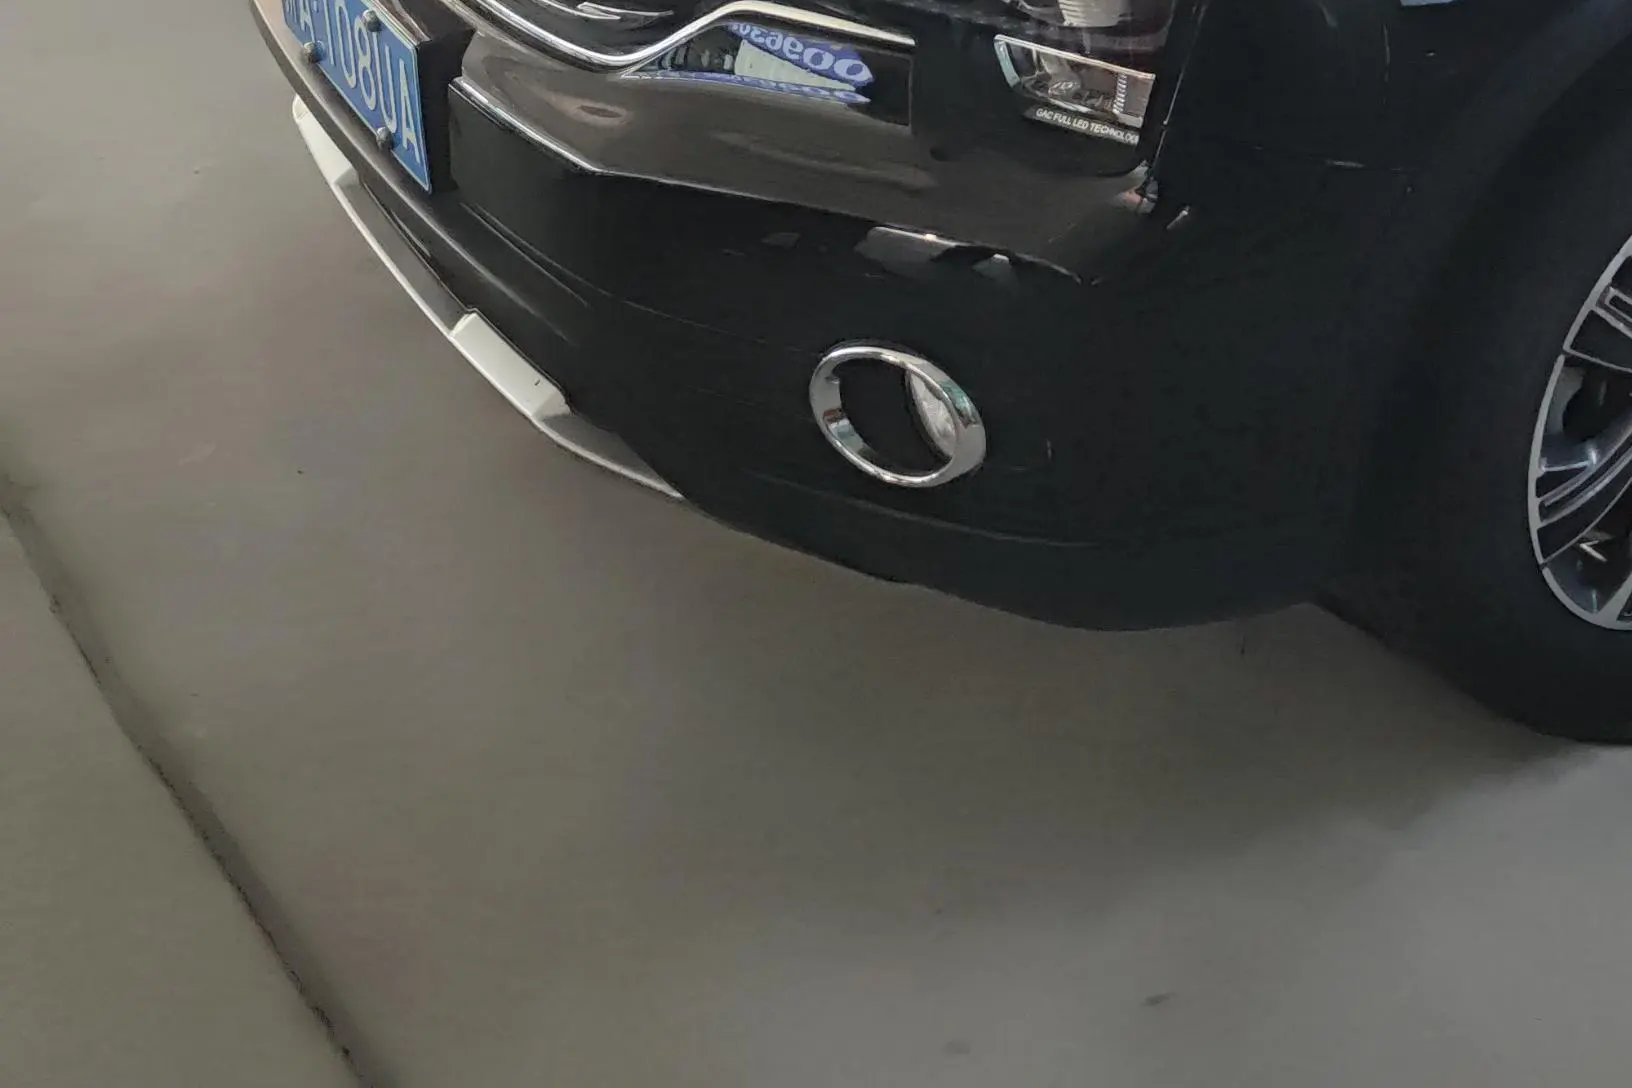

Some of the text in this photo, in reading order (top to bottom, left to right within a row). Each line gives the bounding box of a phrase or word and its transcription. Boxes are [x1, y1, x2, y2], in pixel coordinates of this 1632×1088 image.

[1036, 108, 1053, 120] GAC
[1053, 113, 1072, 125] FULL
[1072, 118, 1090, 130] LED
